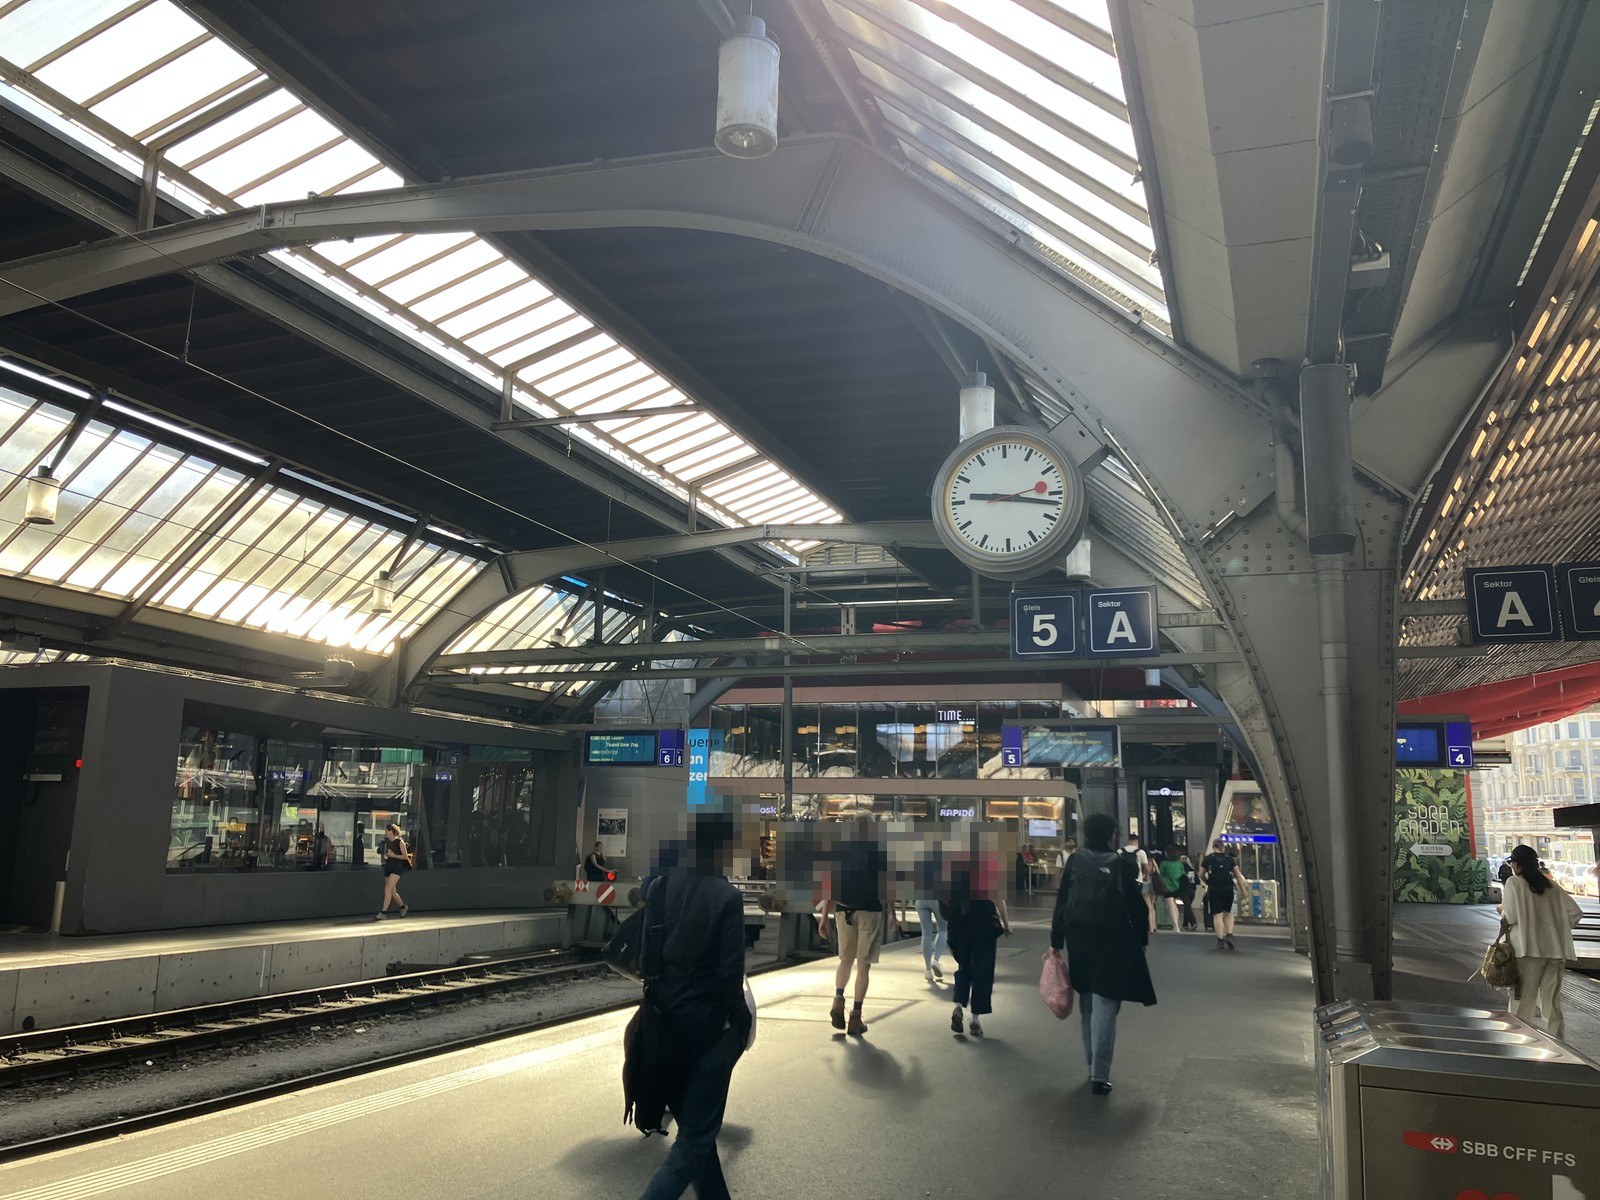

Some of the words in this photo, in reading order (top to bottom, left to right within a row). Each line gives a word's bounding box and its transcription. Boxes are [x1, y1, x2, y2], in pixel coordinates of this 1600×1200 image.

[1483, 581, 1513, 589] Sektor
[1023, 604, 1041, 612] Gleis
[1097, 600, 1122, 608] Sektor
[1496, 591, 1534, 628] A
[1032, 613, 1058, 647] 5
[1106, 611, 1137, 644] A
[664, 754, 671, 764] 6
[1008, 754, 1016, 764] 5
[1455, 753, 1465, 764] 4
[940, 809, 975, 817] RAPIDO
[1408, 805, 1449, 820] SORA
[1399, 820, 1460, 835] GARDEN
[1462, 1140, 1499, 1158] SBB
[1502, 1146, 1538, 1162] CFF
[1542, 1150, 1576, 1167] FFS
